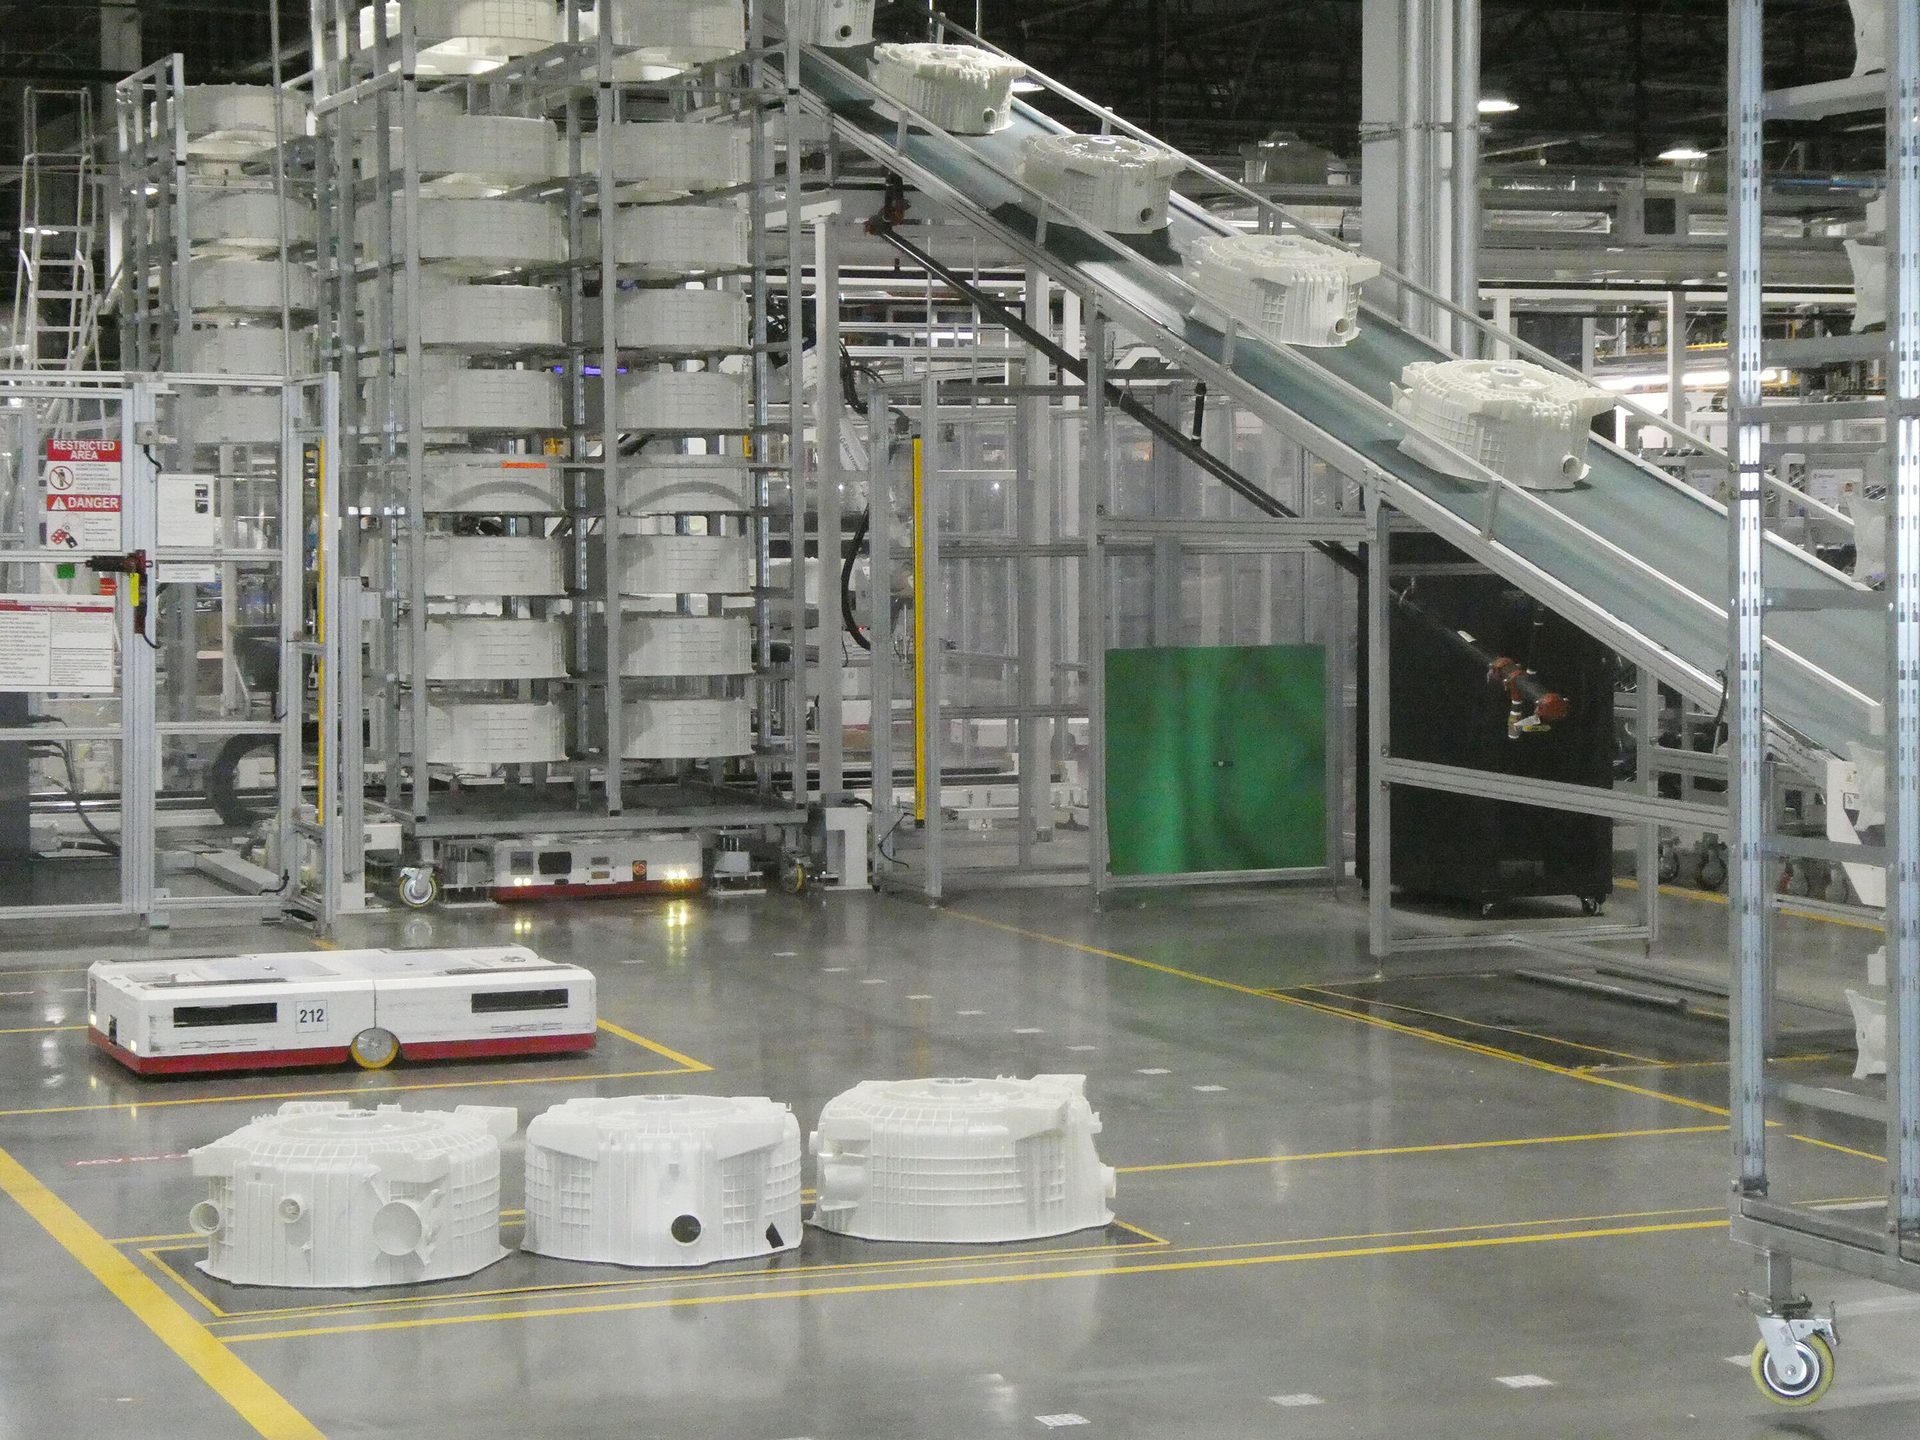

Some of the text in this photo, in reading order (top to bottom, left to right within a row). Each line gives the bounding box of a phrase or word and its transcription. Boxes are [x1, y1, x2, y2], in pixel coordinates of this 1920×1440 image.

[53, 440, 115, 451] RESTRICTED
[70, 450, 99, 460] AREA
[67, 497, 119, 509] DANGER
[299, 1008, 324, 1023] 212
